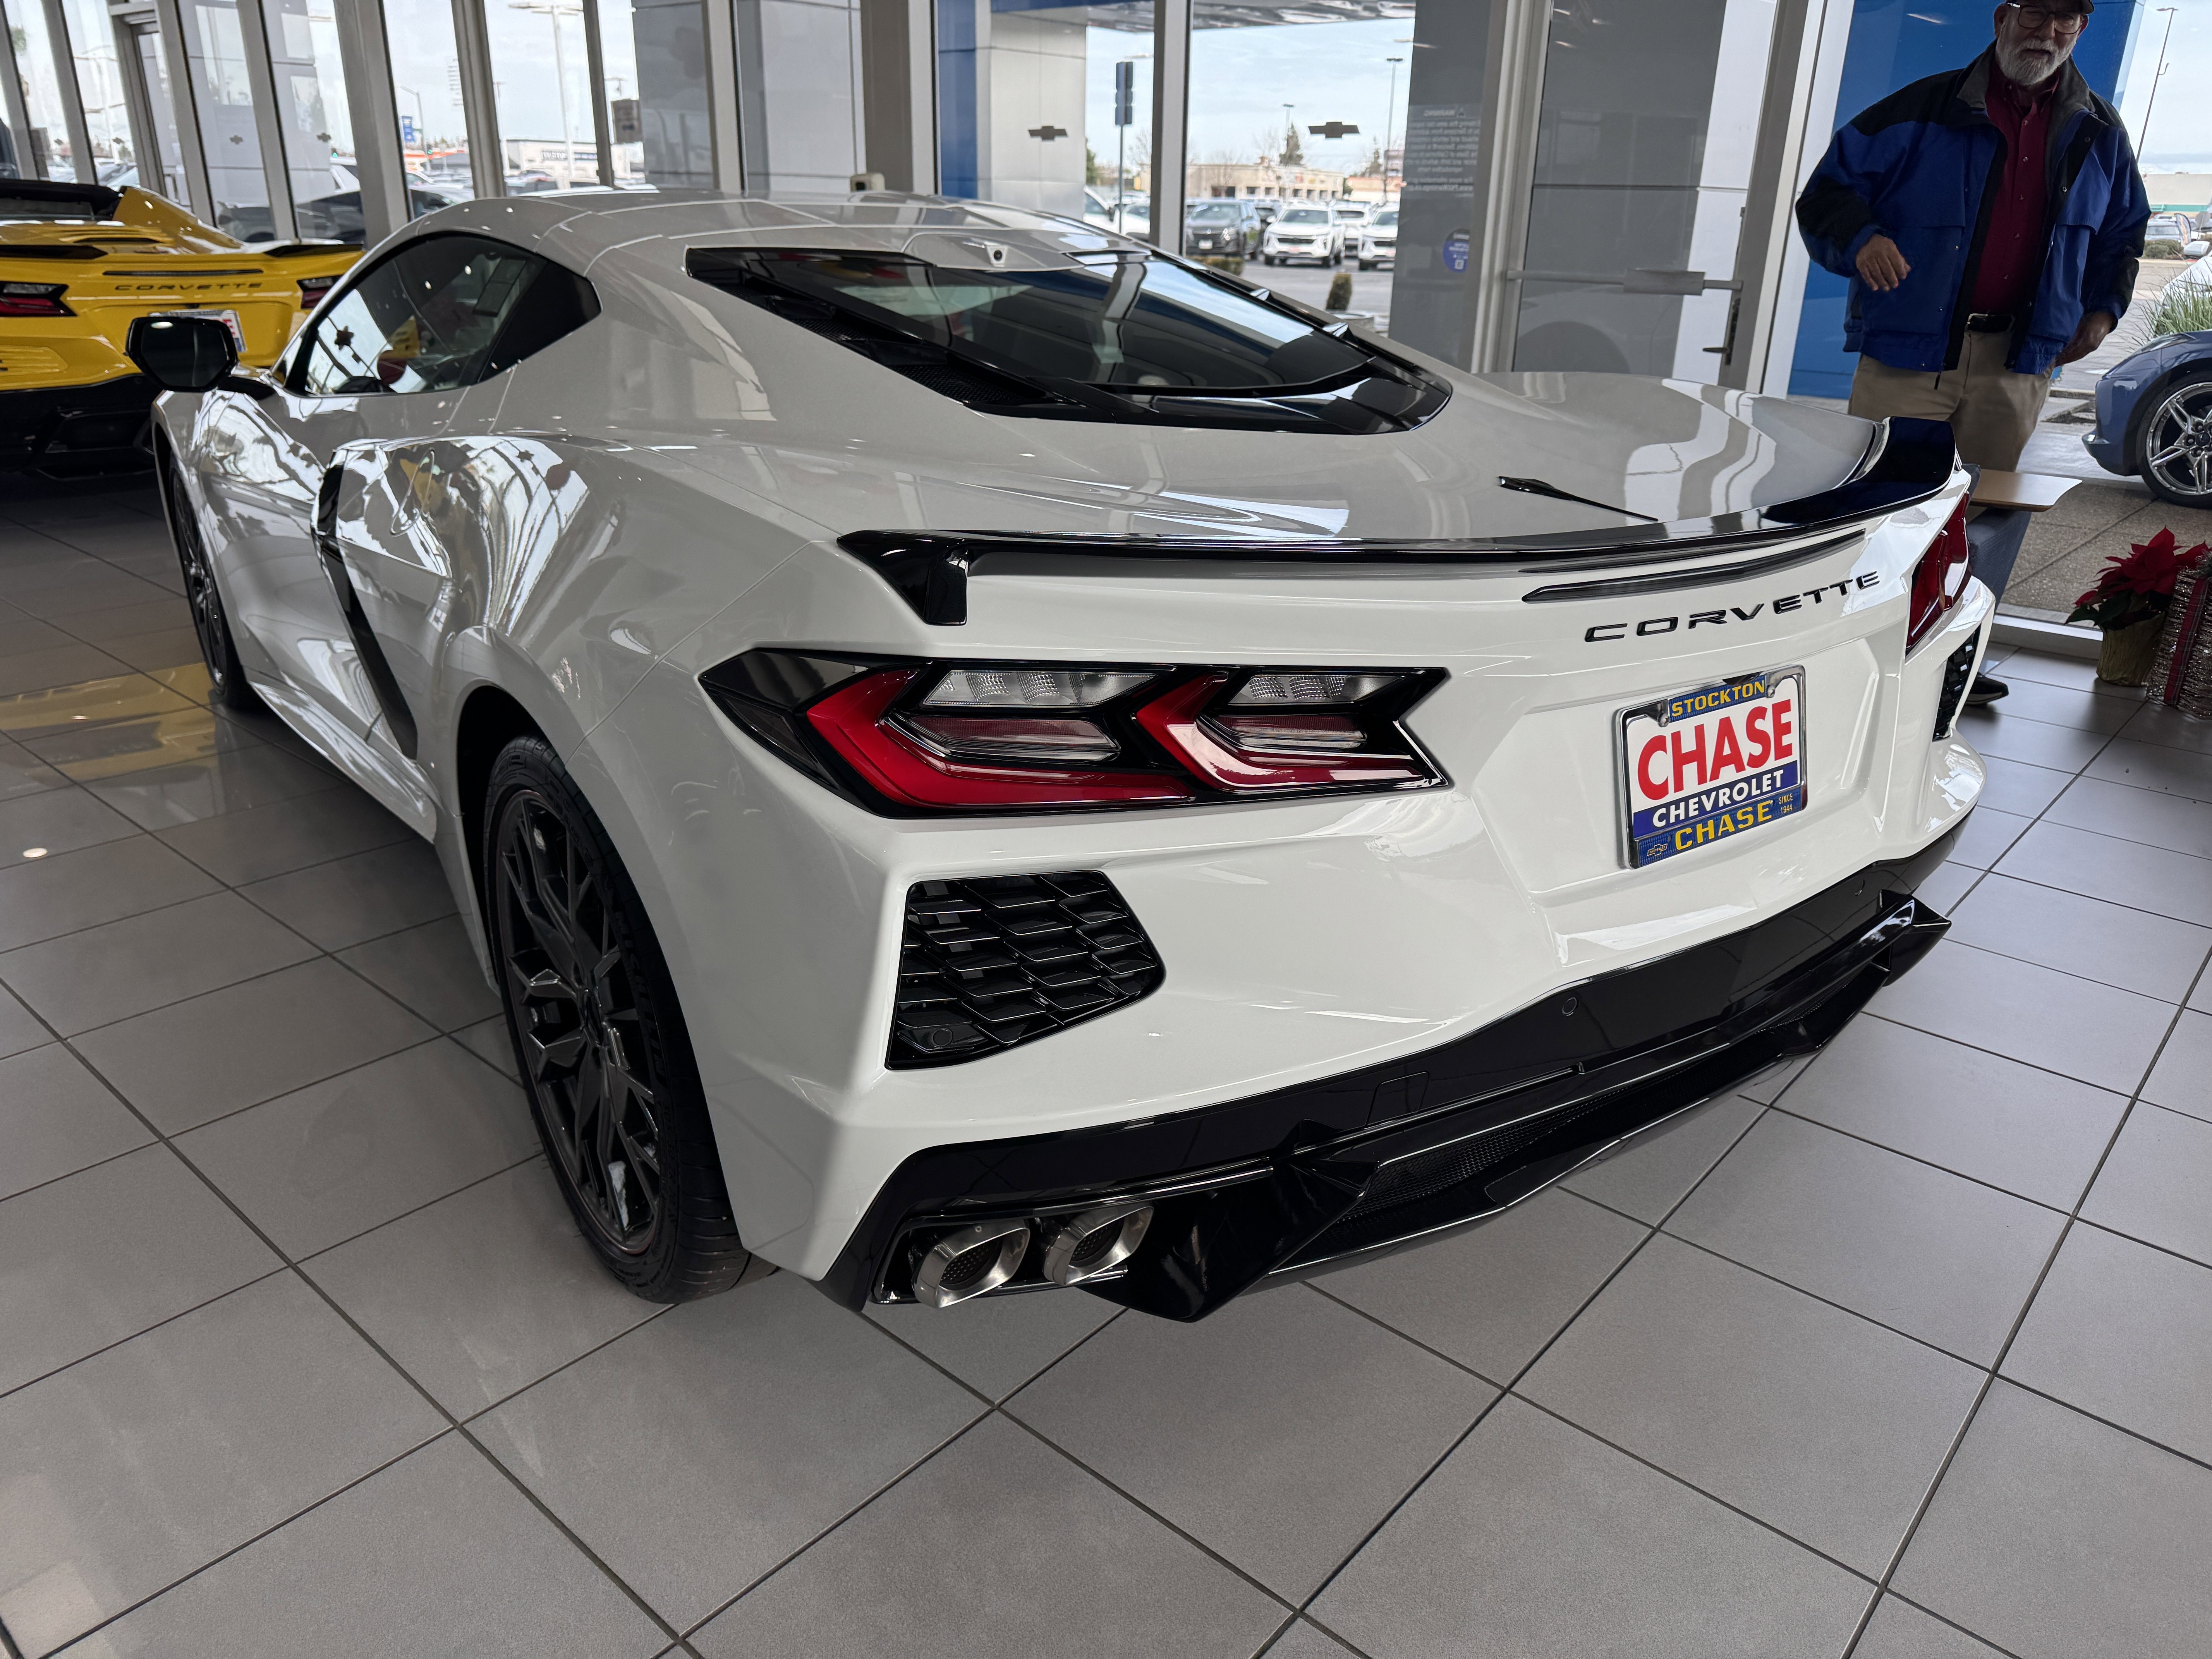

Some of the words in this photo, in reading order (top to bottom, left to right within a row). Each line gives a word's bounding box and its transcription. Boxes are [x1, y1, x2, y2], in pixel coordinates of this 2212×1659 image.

[115, 283, 262, 291] CORVETTE
[1584, 570, 1881, 642] CORVETTE
[1671, 680, 1765, 717] STOCKTON
[1637, 699, 1793, 800] CHASE
[1652, 769, 1784, 827] CHEVROLET
[1779, 793, 1793, 804] SINCE
[1781, 803, 1793, 814] 1944
[1675, 800, 1772, 851] CHASE
[615, 910, 668, 1077] MICHELIN
